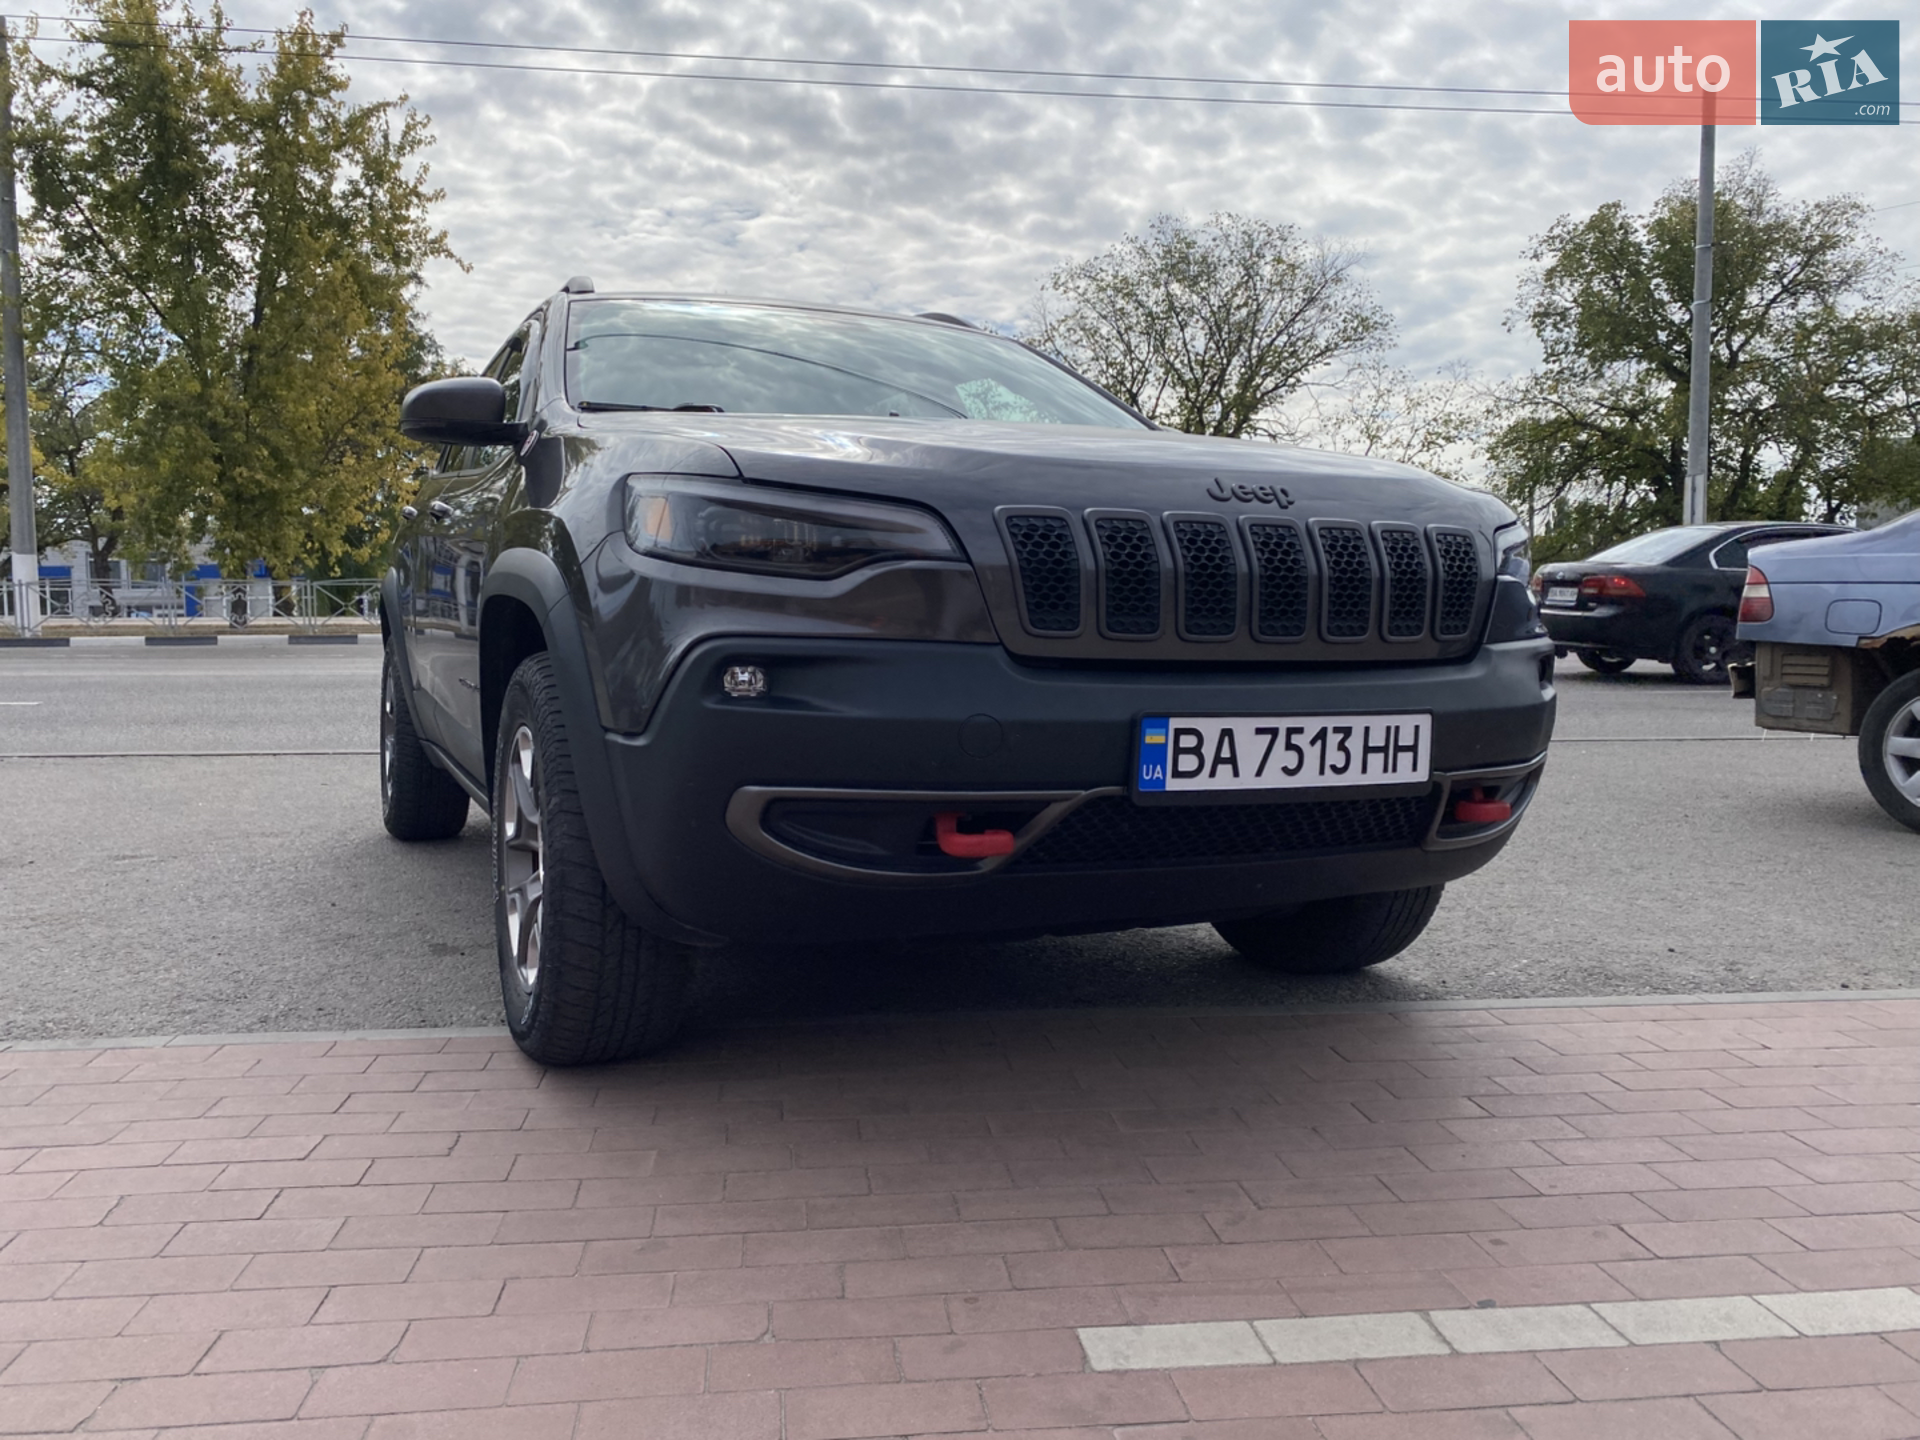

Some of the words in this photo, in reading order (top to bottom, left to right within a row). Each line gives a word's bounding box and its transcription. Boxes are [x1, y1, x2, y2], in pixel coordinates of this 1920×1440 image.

[1206, 477, 1295, 510] Jeep
[1171, 727, 1240, 779] BA
[1254, 726, 1353, 777] 7513
[1360, 724, 1420, 774] HH
[1143, 765, 1163, 780] UA
